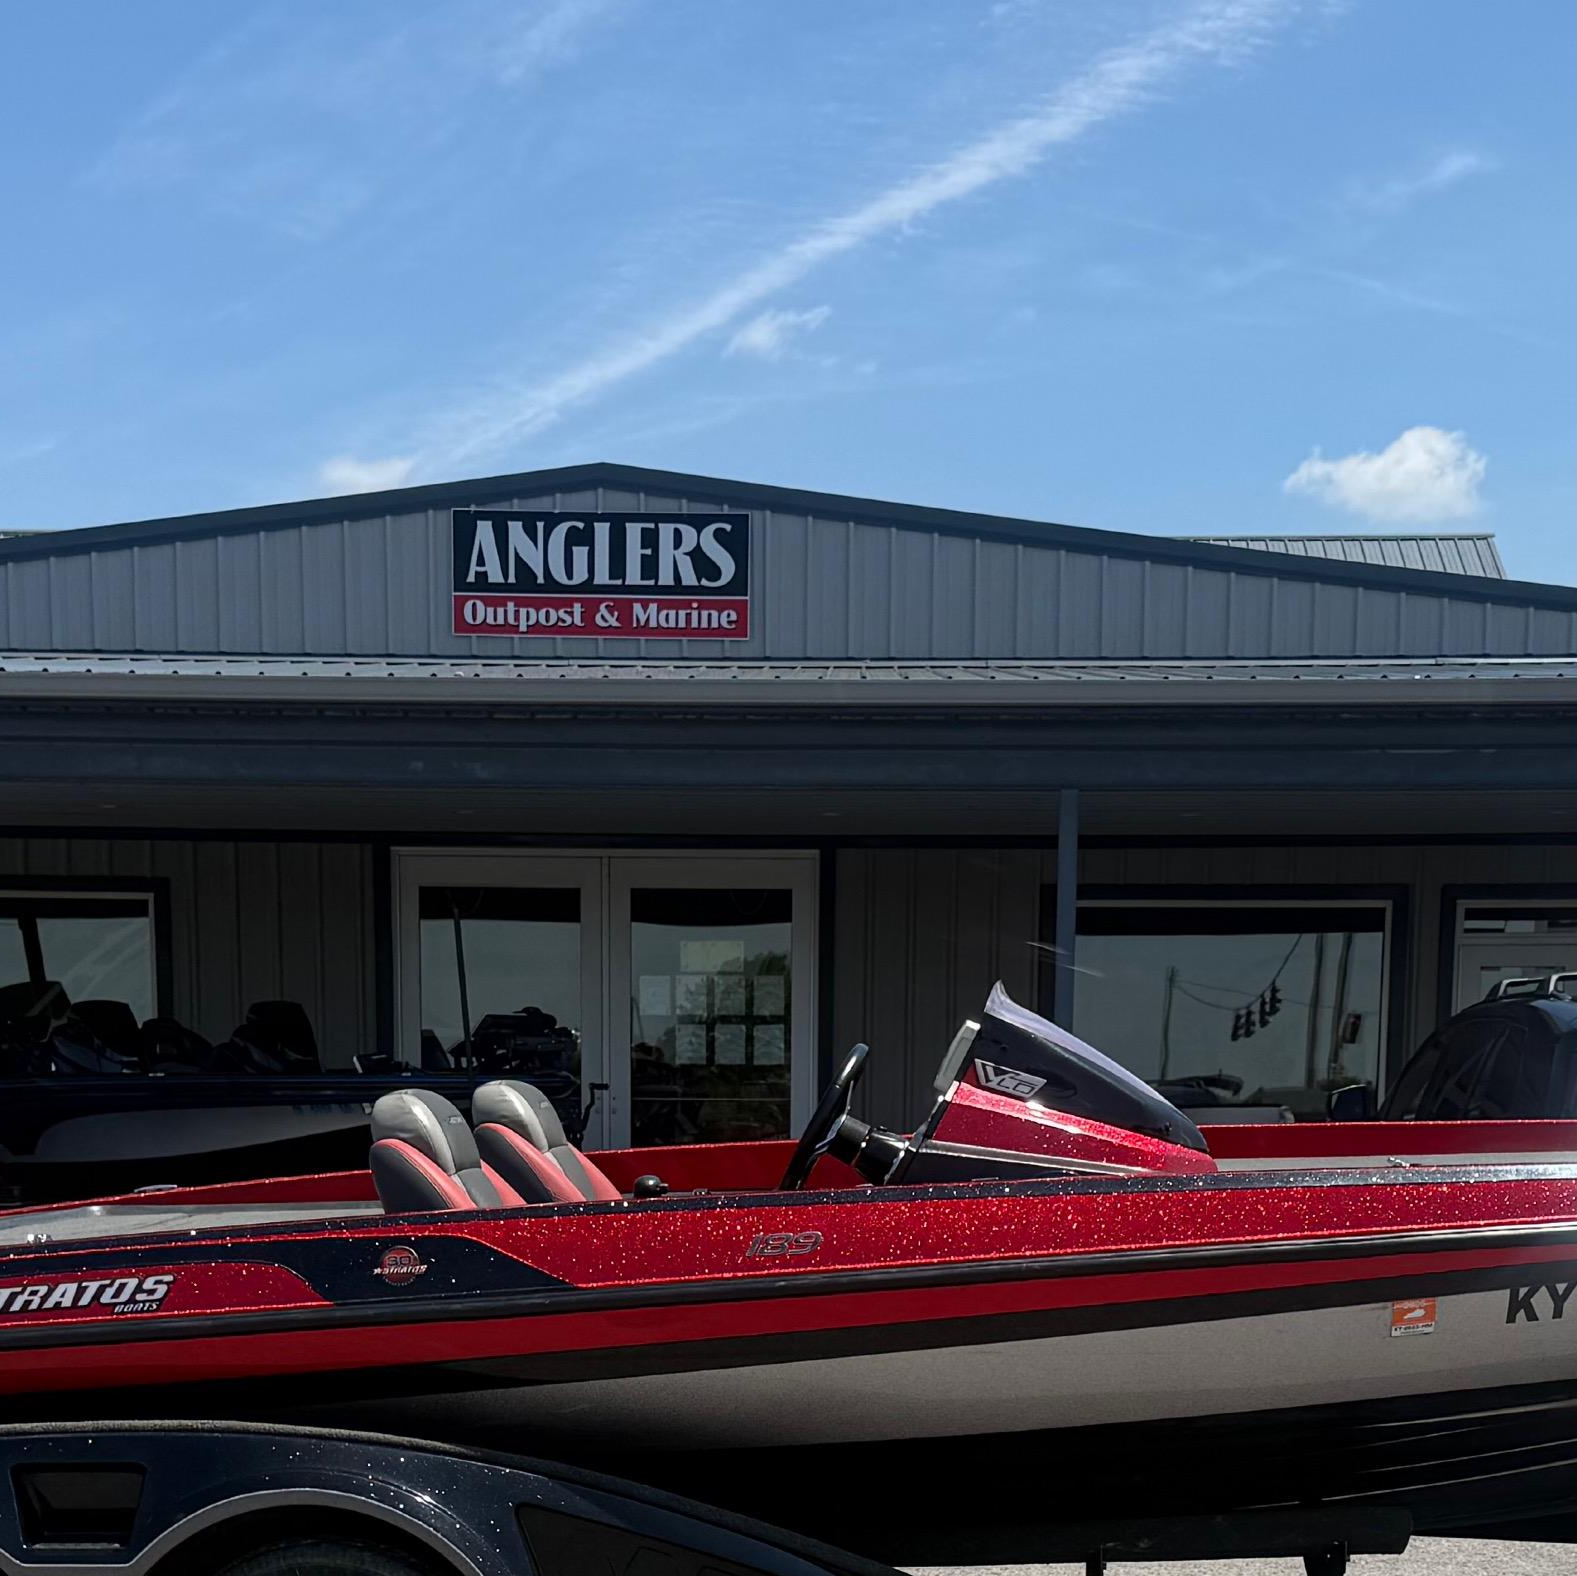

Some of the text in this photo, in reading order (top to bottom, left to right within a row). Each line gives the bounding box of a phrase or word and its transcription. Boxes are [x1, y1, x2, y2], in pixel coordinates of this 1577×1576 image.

[466, 520, 737, 588] ANGLERS
[463, 600, 738, 632] Outpost & Marine
[745, 1231, 824, 1257] 189
[1505, 1281, 1577, 1324] KY
